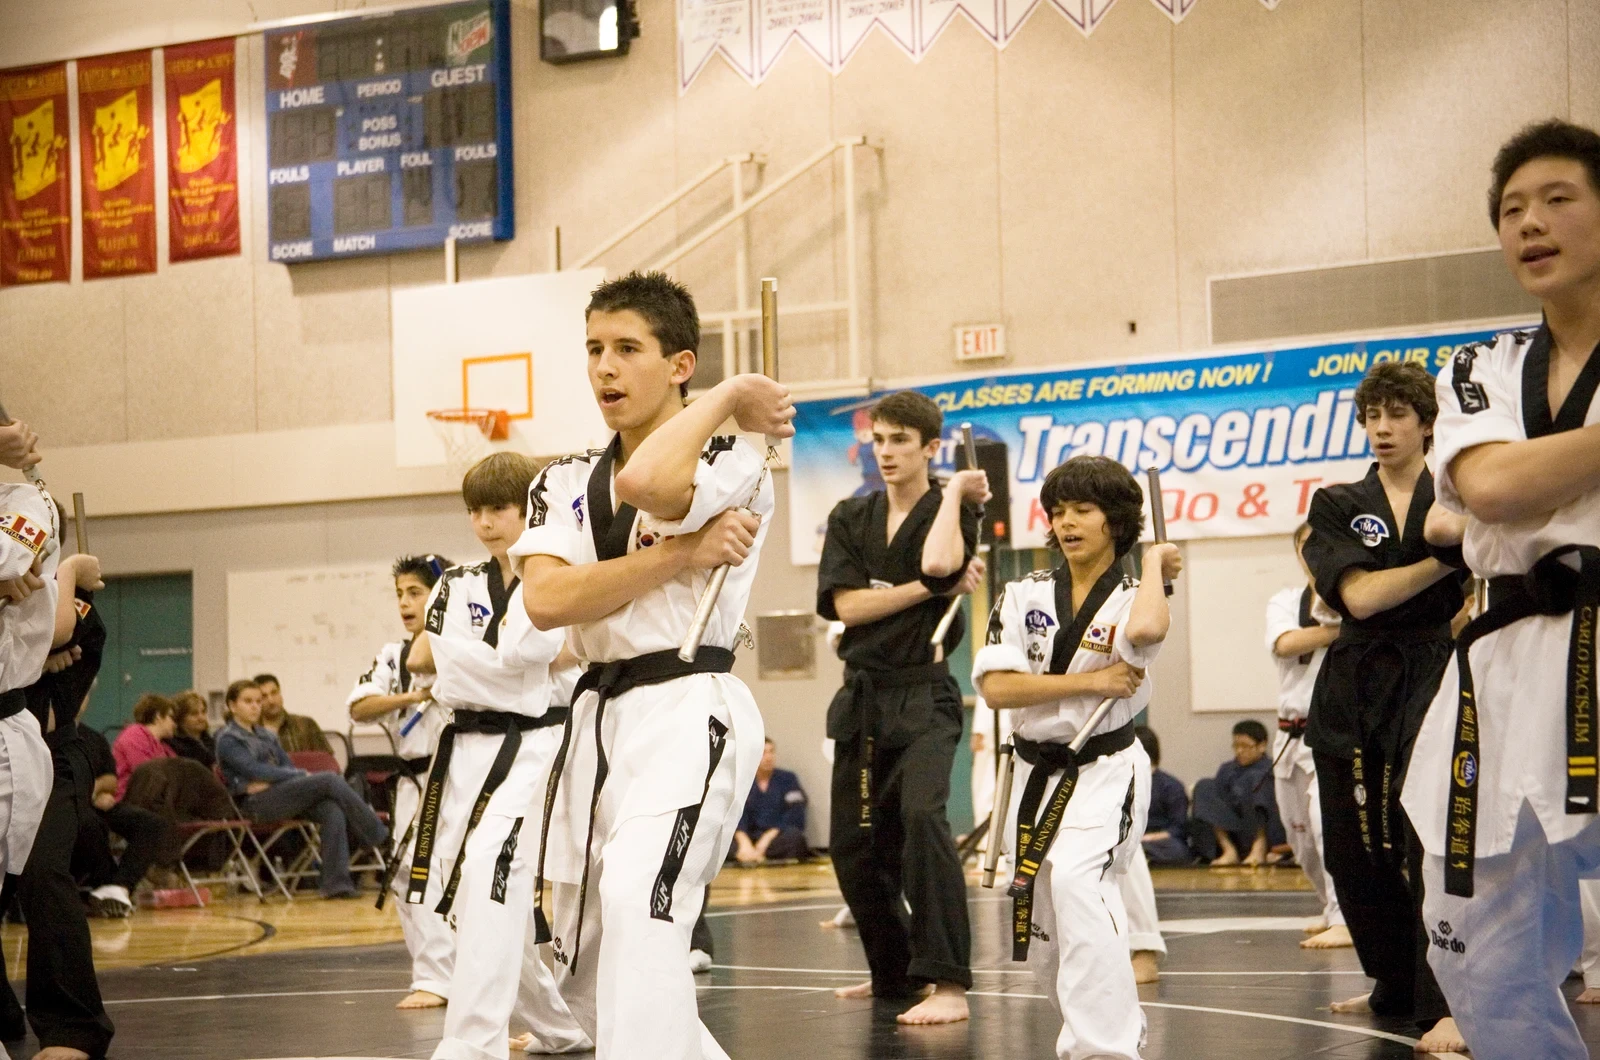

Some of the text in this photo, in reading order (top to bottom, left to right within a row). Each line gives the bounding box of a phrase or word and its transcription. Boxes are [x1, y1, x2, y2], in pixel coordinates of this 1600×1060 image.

[431, 64, 486, 88] GUEST
[280, 86, 325, 109] HOME
[357, 79, 401, 98] PERIOD
[362, 115, 397, 133] POSS
[359, 133, 401, 151] BONUS
[400, 152, 432, 168] FOUL
[454, 144, 497, 161] FOULS
[269, 165, 310, 184] FOULS
[337, 157, 385, 176] PLAYER
[448, 221, 492, 240] SCORE
[272, 241, 313, 260] SCORE
[333, 235, 376, 253] MATCH
[962, 328, 998, 355] EXIT
[1309, 349, 1370, 378] JOIN
[934, 382, 1035, 412] CLASSES
[1034, 378, 1085, 403] ARE
[1086, 368, 1196, 398] FORMING
[1198, 363, 1261, 389] NOW
[1236, 481, 1270, 519] &
[1359, 520, 1378, 534] TMA
[1575, 606, 1591, 743] CARLO PACIS-LIM
[1464, 759, 1473, 781] TMA
[419, 781, 440, 858] NATHAN KAISER
[1033, 779, 1073, 851] JULIAN INFANTI
[1431, 929, 1465, 954] Dae do
